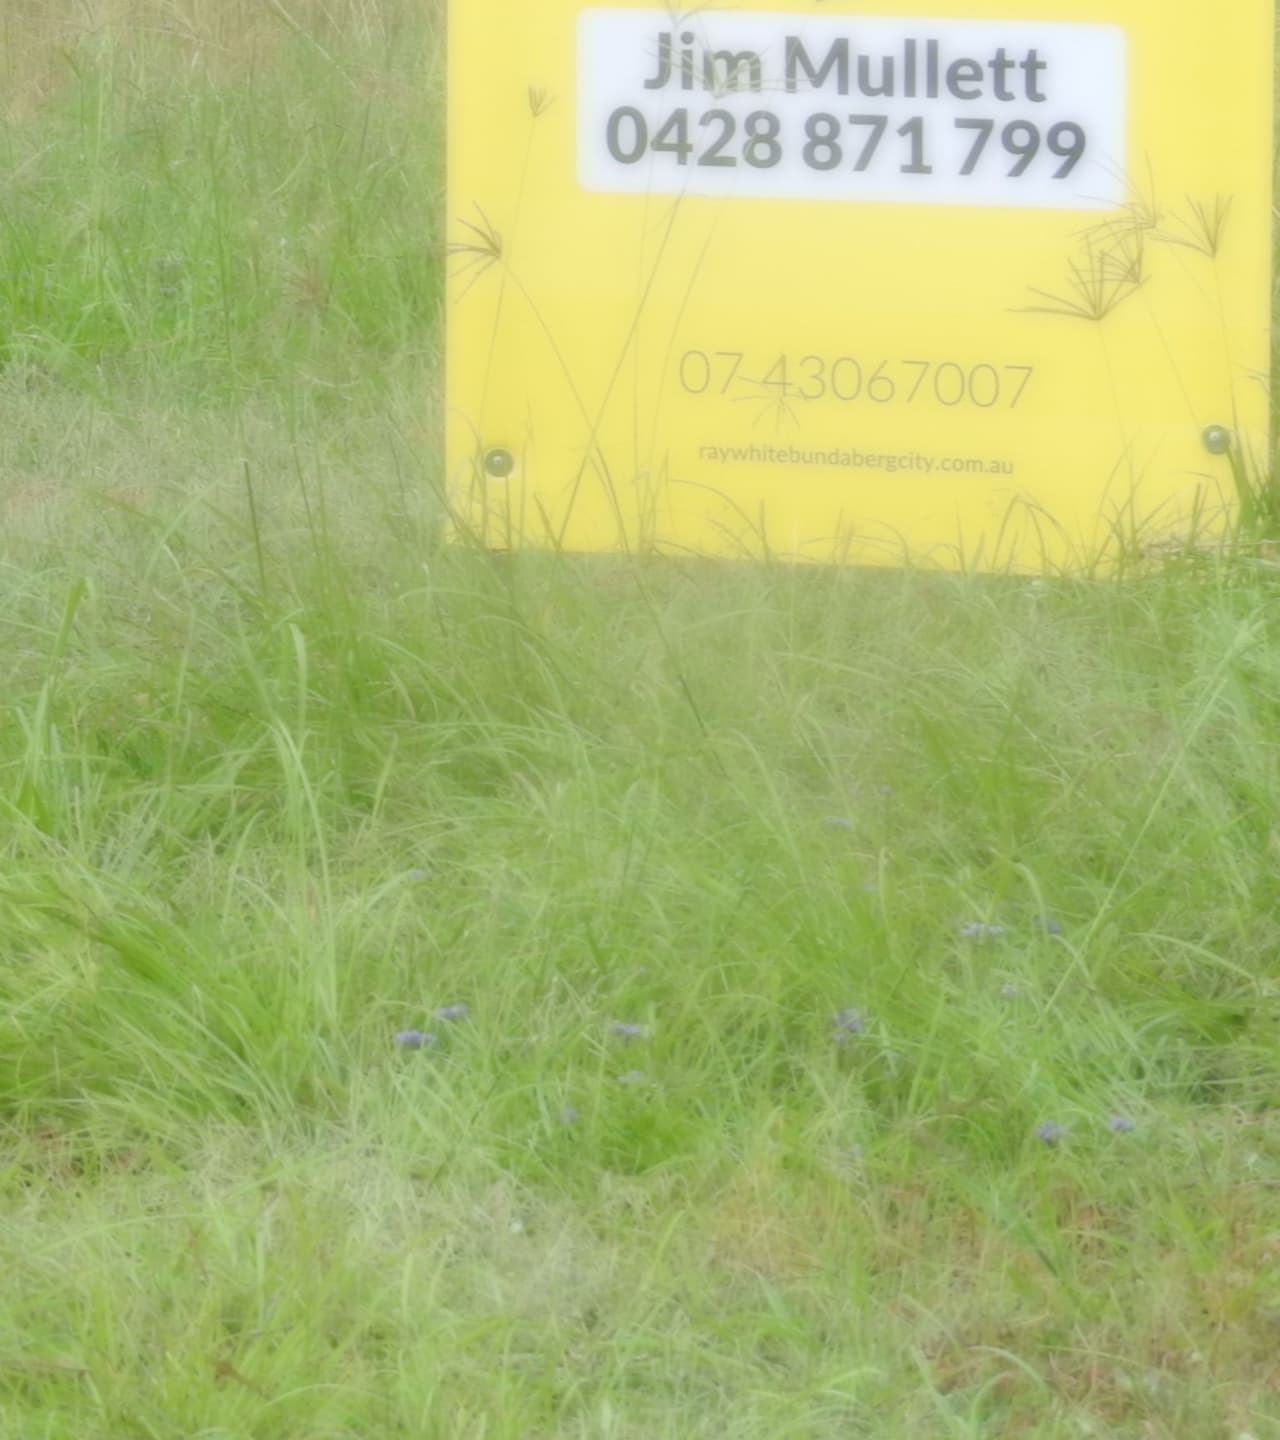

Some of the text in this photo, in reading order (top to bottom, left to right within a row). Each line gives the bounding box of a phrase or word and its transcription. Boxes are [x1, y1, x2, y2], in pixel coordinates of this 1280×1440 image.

[642, 31, 1049, 103] Jim Mullett
[604, 105, 1088, 180] 0428 871 799
[678, 349, 1034, 409] 07 43067007
[697, 443, 1015, 476] raywhitebundabergcity.com.au
